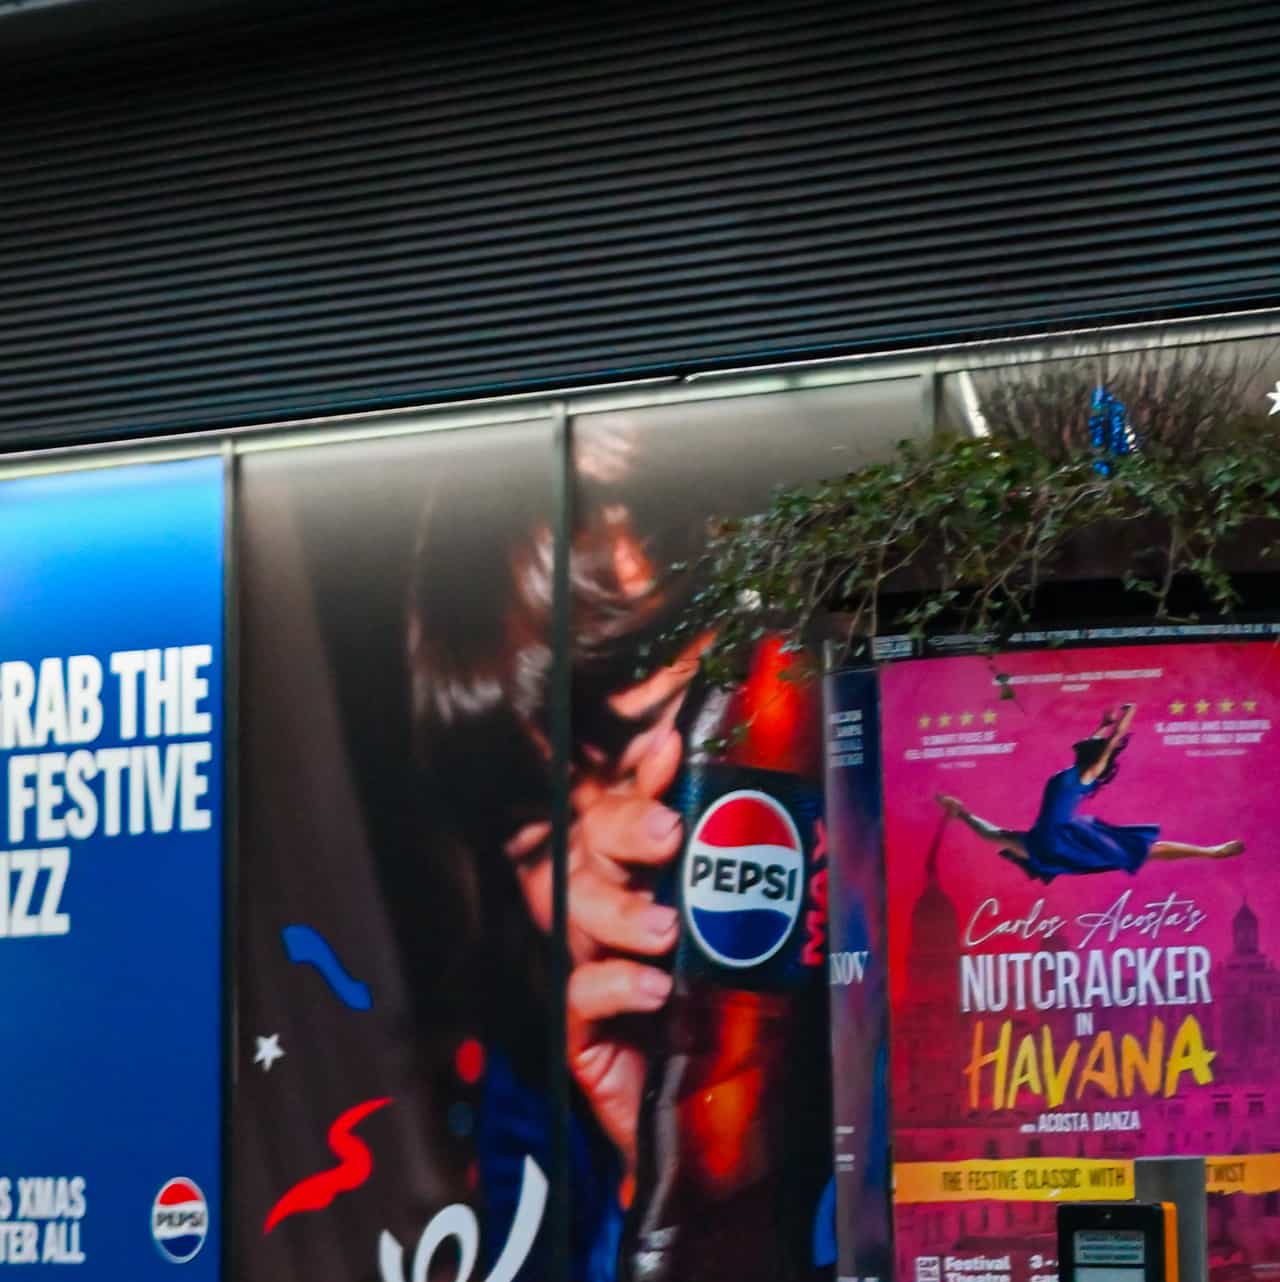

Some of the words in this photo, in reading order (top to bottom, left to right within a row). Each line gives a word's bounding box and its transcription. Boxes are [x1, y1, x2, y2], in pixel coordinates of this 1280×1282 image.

[110, 645, 213, 740] THE
[8, 741, 212, 844] FESTIVE
[690, 855, 798, 901] PEPSI
[964, 898, 1067, 946] Carlos
[1076, 889, 1207, 949] Acosta's
[959, 945, 1213, 1013] NUTCRACKER
[1076, 1012, 1094, 1037] IN
[963, 1014, 1217, 1110] HAVANA
[1038, 1112, 1089, 1132] ACOSTA
[1093, 1110, 1140, 1131] DANZA
[17, 1175, 87, 1219] XMAS
[968, 1170, 1018, 1190] FESTIVE
[1024, 1168, 1081, 1190] CLASSIC
[1088, 1167, 1126, 1187] WITH
[156, 1211, 204, 1228] PEPSI
[41, 1220, 87, 1264] ALL
[944, 1255, 1011, 1271] Festival
